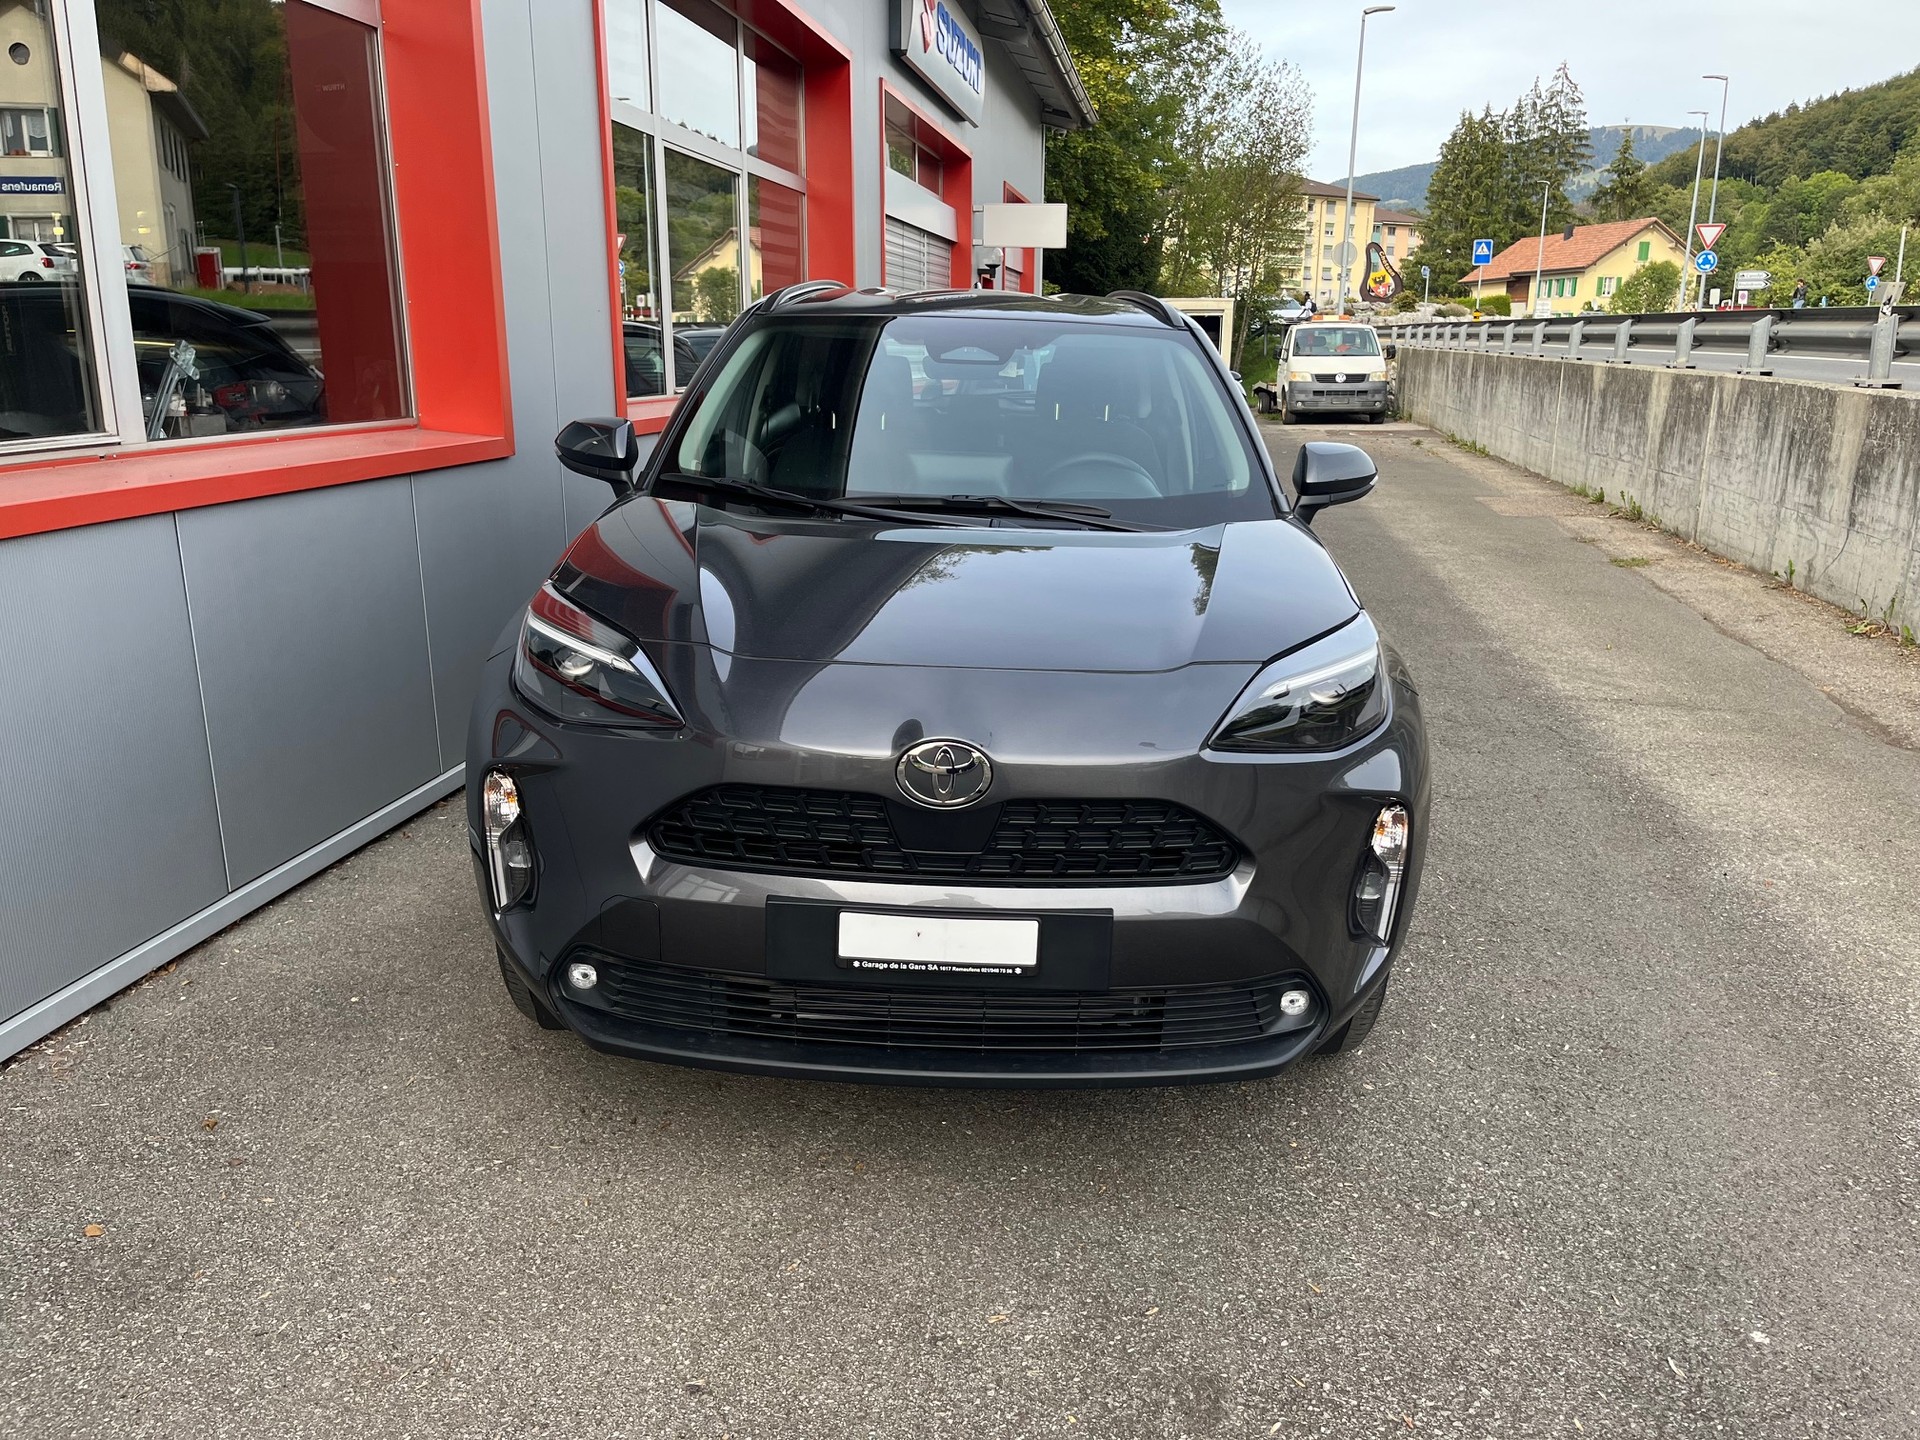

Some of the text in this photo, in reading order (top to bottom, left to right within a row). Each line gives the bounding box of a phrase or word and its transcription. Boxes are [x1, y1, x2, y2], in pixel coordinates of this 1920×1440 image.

[936, 1, 981, 95] SUZUKI
[861, 960, 888, 970] Garage
[900, 962, 907, 970] la
[908, 963, 926, 971] Gare
[927, 963, 939, 971] SA
